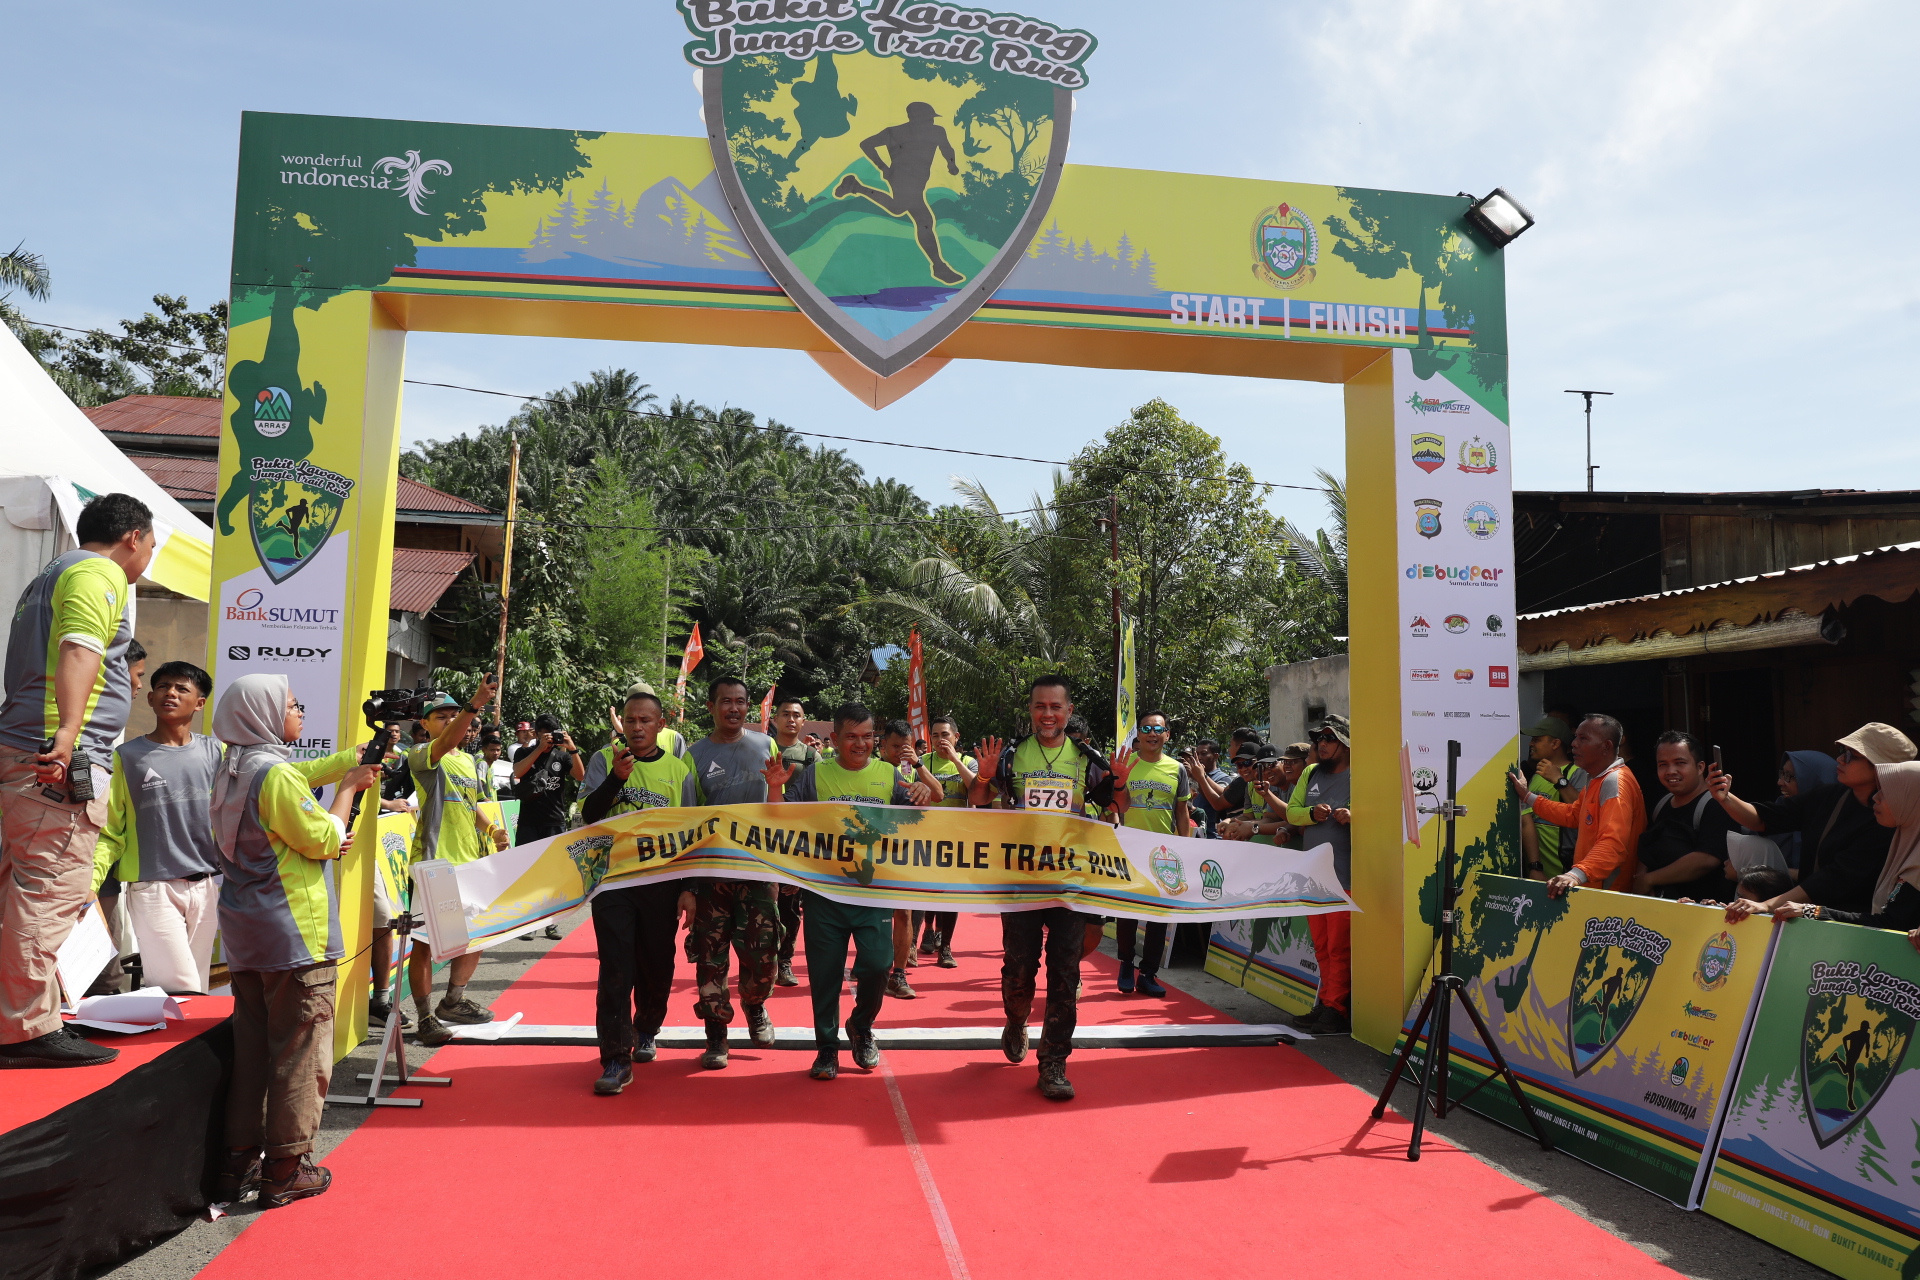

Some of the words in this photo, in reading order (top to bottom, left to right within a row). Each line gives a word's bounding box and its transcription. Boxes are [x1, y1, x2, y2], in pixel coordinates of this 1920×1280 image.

[688, 0, 858, 28] Bukit
[865, 0, 1088, 60] Lawang
[695, 25, 861, 61] Jungle
[872, 26, 980, 61] Trail
[994, 43, 1081, 84] Run
[281, 153, 362, 168] wonderful
[279, 167, 392, 189] indonesia
[1171, 294, 1265, 330] START
[1309, 302, 1406, 339] FINISH
[250, 470, 294, 481] Jungle
[296, 473, 324, 488] Trail
[325, 482, 349, 499] Run
[251, 458, 295, 470] Bukit
[296, 461, 354, 490] Lawang
[1406, 563, 1504, 581] disbudpar
[257, 646, 332, 658] RUDY
[1492, 671, 1507, 680] BIB
[1027, 788, 1069, 809] 578
[729, 821, 855, 862] LAWANG
[875, 837, 990, 869] JUNGLE
[1000, 842, 1082, 872] TRAIL
[1087, 850, 1132, 882] RUN
[1582, 933, 1618, 947] Jungle
[1619, 934, 1643, 952] Trail
[1643, 943, 1662, 964] Run
[1586, 918, 1622, 934] Bukit
[1621, 919, 1669, 954] Lawang
[1813, 962, 1860, 979] Bukit
[1808, 979, 1858, 996] Jungle
[1860, 982, 1894, 1004] Trail
[1670, 1029, 1715, 1048] disbudpar
[1643, 1090, 1698, 1120] #DISUMUTAJA
[1533, 1106, 1553, 1122] LAWANG
[1552, 1114, 1571, 1130] JUNGLE
[1571, 1122, 1586, 1137] TRAIL
[1586, 1130, 1599, 1142] RUN
[1712, 1179, 1733, 1196] BUKIT
[1732, 1187, 1761, 1209] LAWANG
[1761, 1202, 1789, 1222] JUNGLE
[1790, 1213, 1811, 1232] TRAIL
[1812, 1223, 1830, 1240] RUN
[1831, 1232, 1857, 1251] BUKIT
[1857, 1244, 1895, 1269] LAWANG
